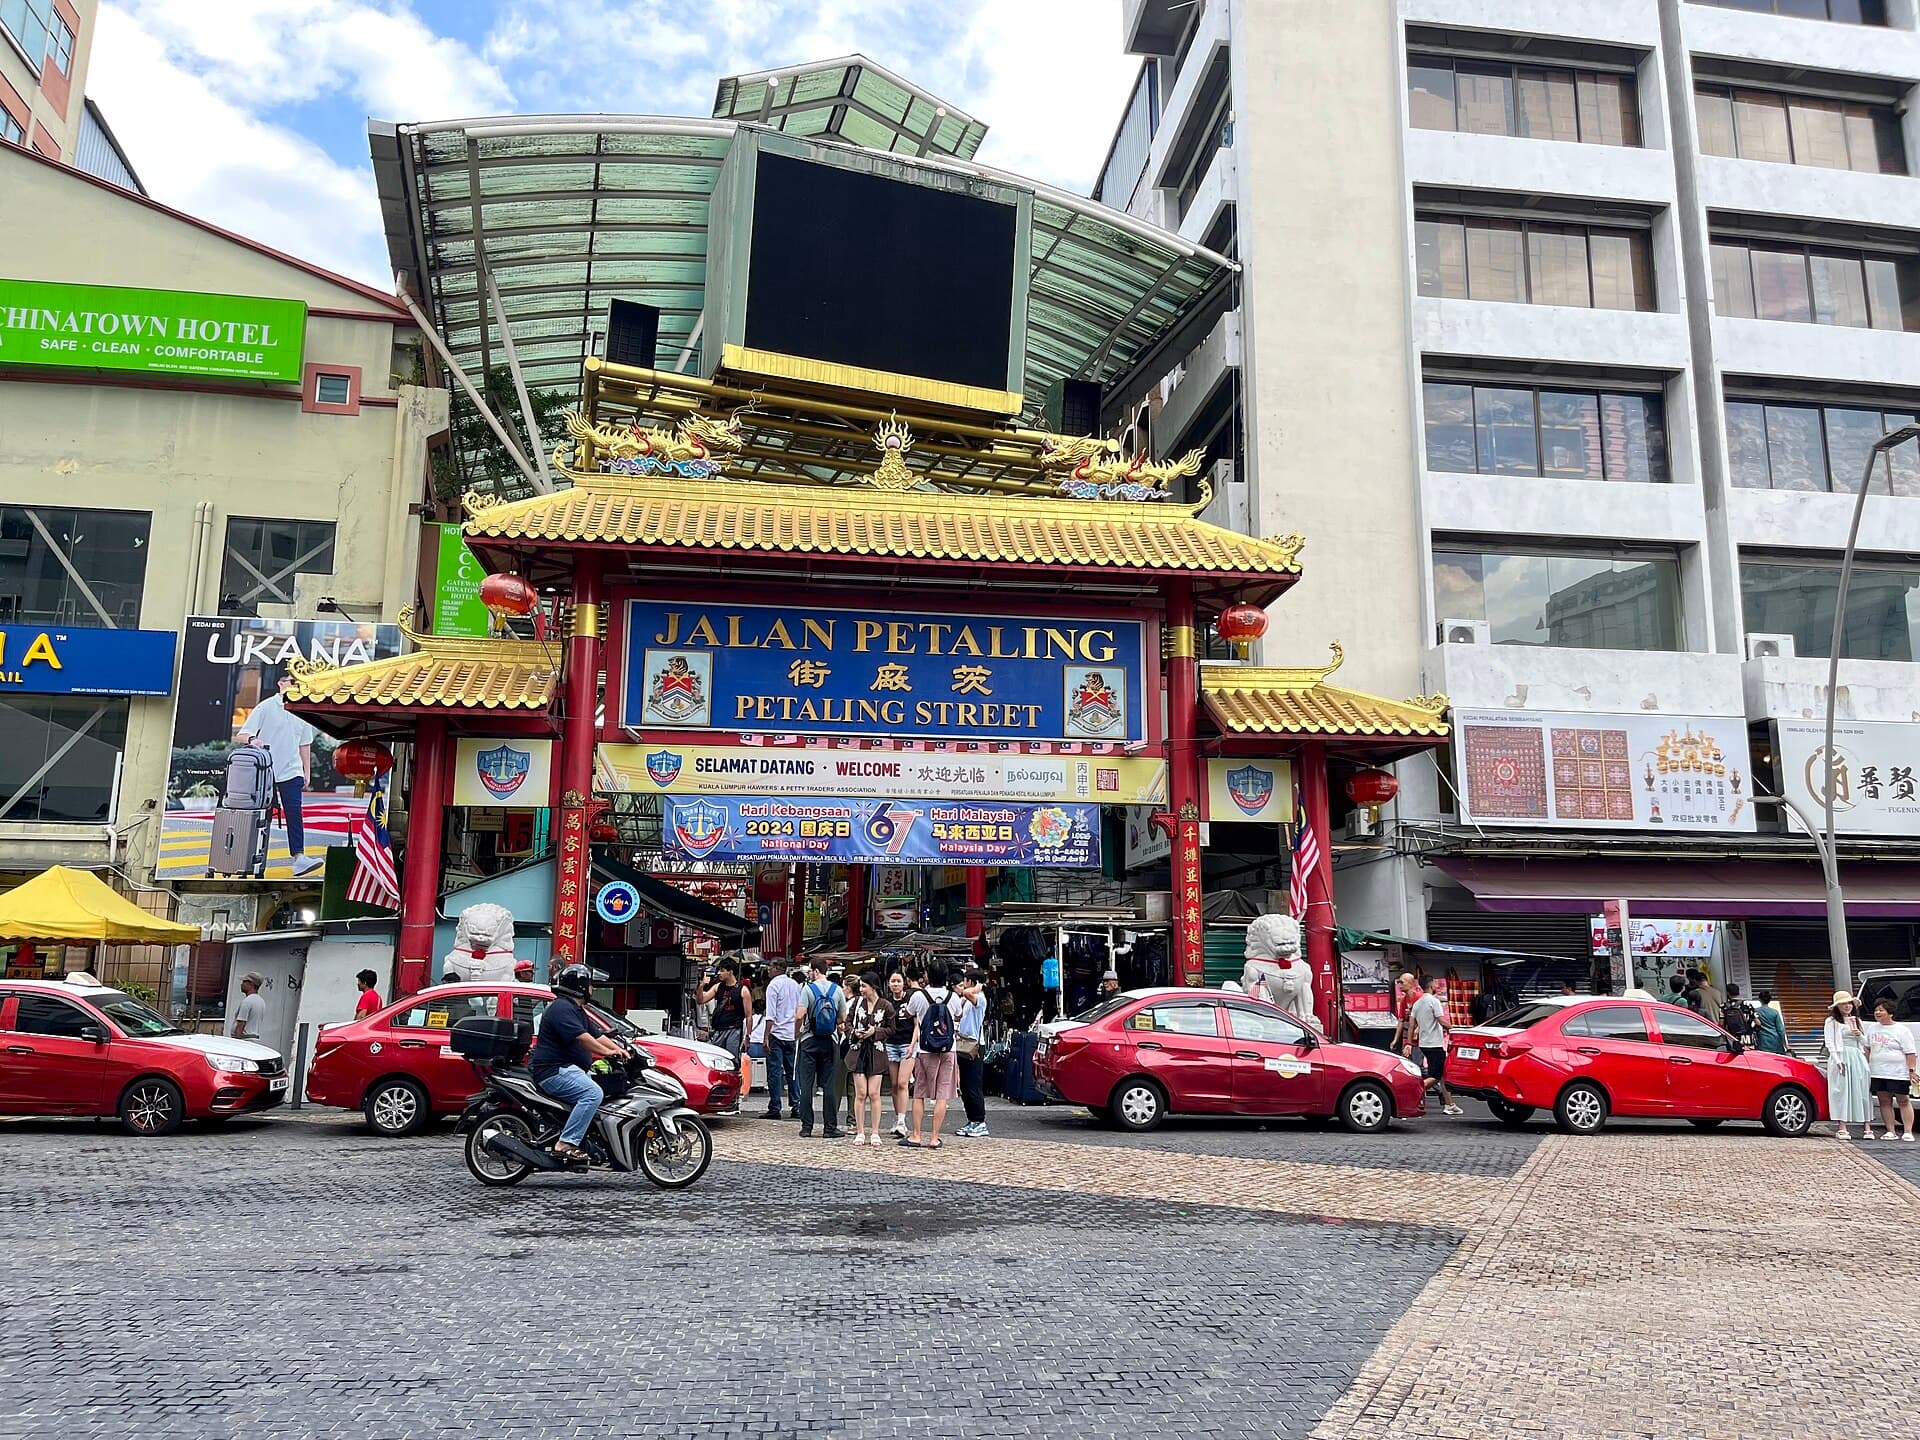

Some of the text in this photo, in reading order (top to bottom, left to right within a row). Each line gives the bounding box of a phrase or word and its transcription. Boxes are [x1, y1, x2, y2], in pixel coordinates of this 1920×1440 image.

[176, 317, 278, 347] HOTEL
[40, 338, 264, 364] SAFE CLEAN COMFORTABLE
[655, 612, 1117, 662] JALAN PETALING
[735, 695, 905, 724] PETALING
[915, 700, 1043, 728] STREET
[695, 757, 757, 773] SELAMAT
[760, 759, 815, 775] DATANG
[836, 761, 901, 777] WELCOME
[917, 765, 985, 784] 欢迎光临
[1077, 762, 1088, 797] 丙申年
[740, 803, 851, 819] Hari Kebangsaan
[931, 809, 1016, 823] Hari Malaysia
[746, 821, 850, 837] 2024 国庆日
[865, 802, 914, 854] 67
[932, 823, 1013, 841] 马来西亚日
[761, 839, 829, 851] National Day
[939, 843, 1007, 855] Malaysia Day
